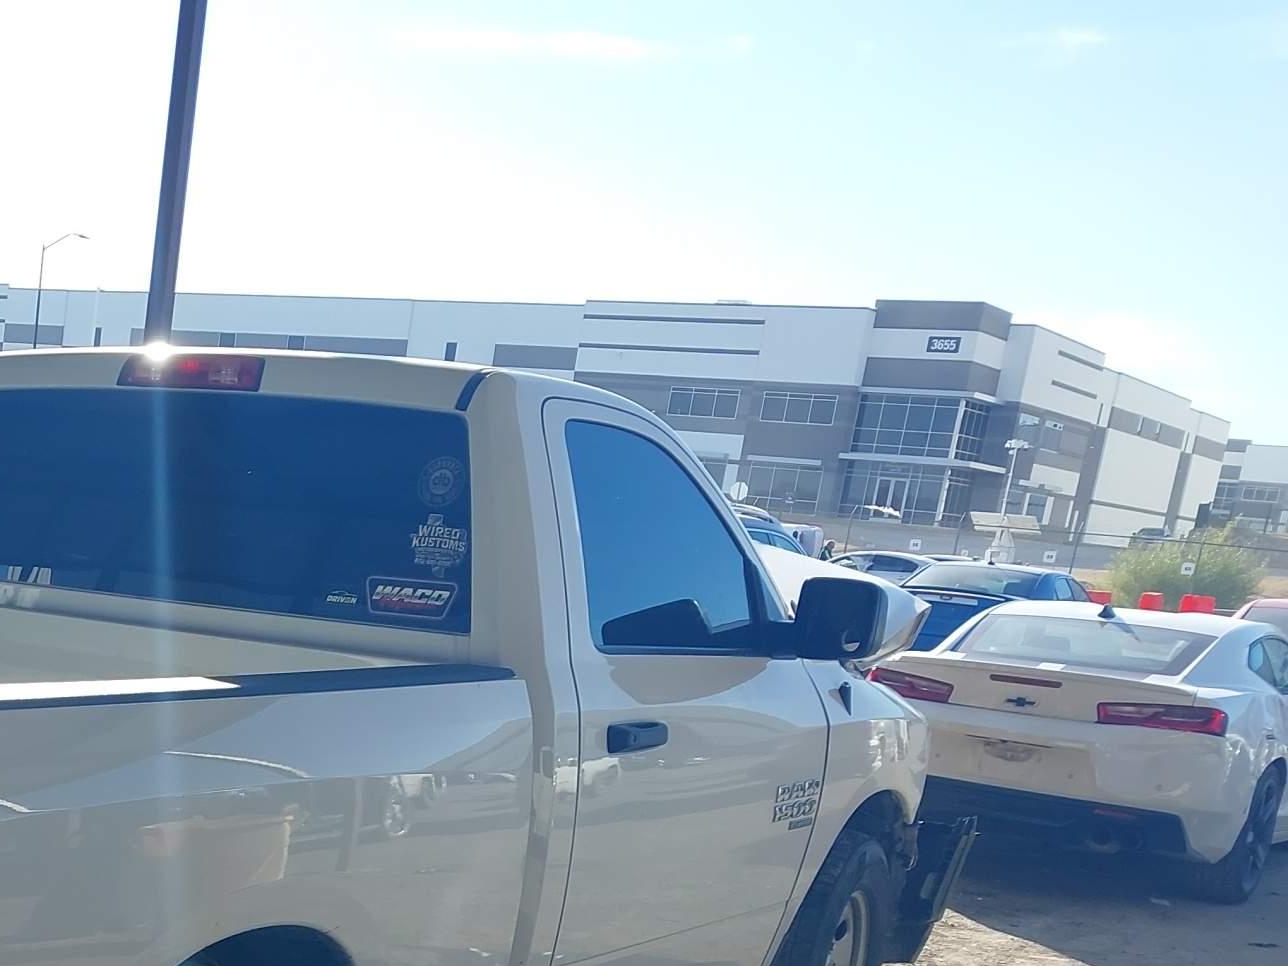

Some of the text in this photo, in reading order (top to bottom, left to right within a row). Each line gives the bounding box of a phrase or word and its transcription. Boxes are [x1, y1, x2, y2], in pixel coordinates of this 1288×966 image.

[931, 339, 956, 351] 3655
[418, 524, 460, 540] WIRED
[411, 536, 466, 551] KUSTOMS
[326, 595, 358, 604] DRIVEN
[773, 798, 817, 823] 1500
